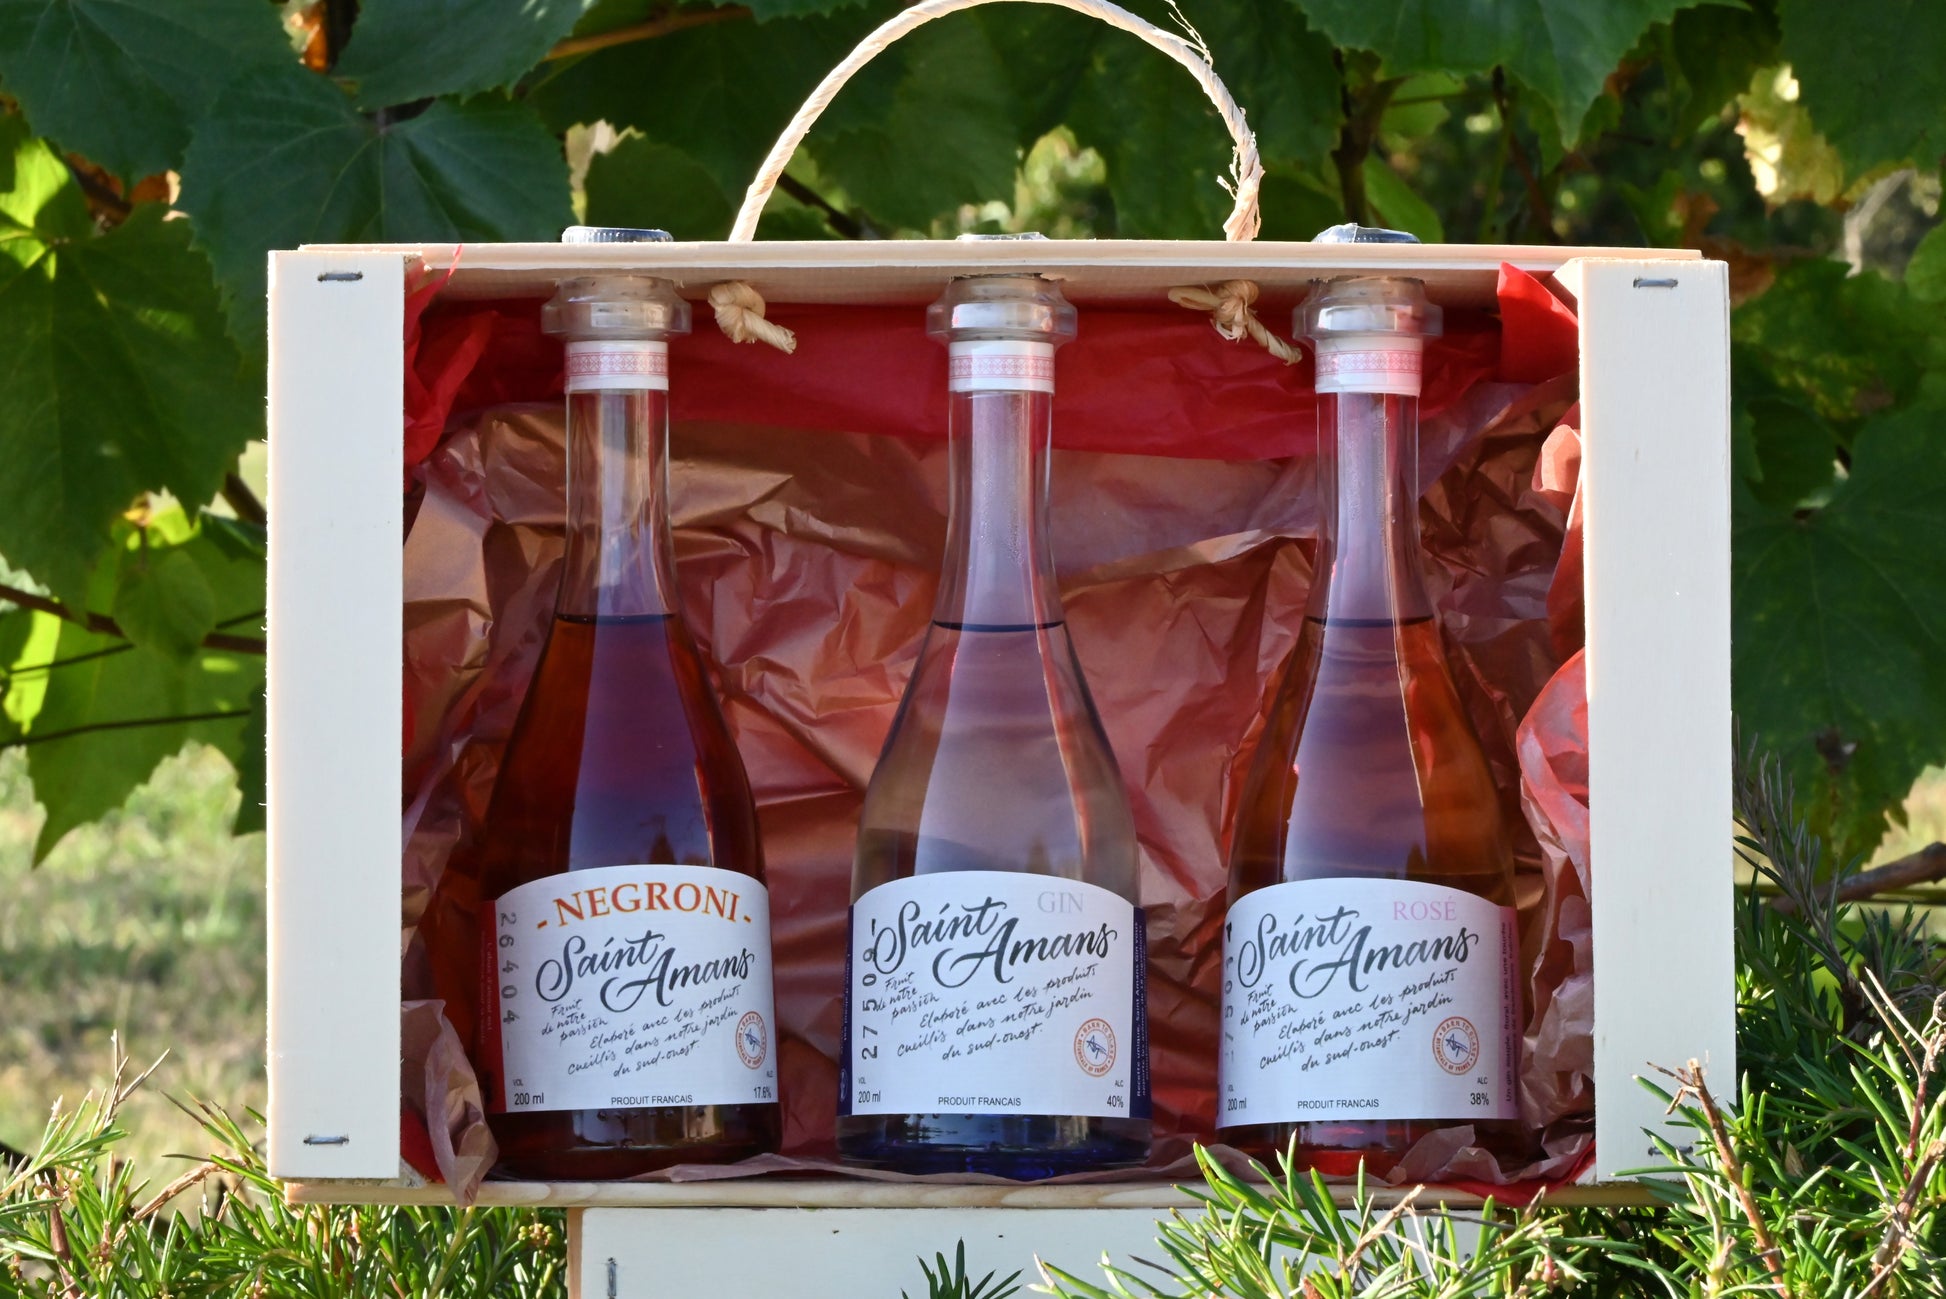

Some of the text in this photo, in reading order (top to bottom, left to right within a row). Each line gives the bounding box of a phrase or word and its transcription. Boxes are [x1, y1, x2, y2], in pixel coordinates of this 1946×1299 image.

[1037, 891, 1084, 914] GIN
[932, 917, 1118, 988] Amans
[1289, 925, 1479, 999] Amans
[599, 947, 755, 1013] Amans
[885, 971, 915, 992] Fruit
[874, 986, 918, 1012] de notre
[920, 963, 1099, 1028] Elaboré avec les produits
[1247, 983, 1274, 1006] Fruit
[1278, 968, 1458, 1040] Elaboré avec les produits
[551, 999, 582, 1018] Fruit
[589, 984, 741, 1049] Elaboré avec les produits
[891, 992, 940, 1025] passion
[956, 1017, 995, 1036] dans
[1001, 1002, 1045, 1023] notre
[1045, 986, 1093, 1019] jardin
[1240, 998, 1277, 1026] de notre
[1314, 1026, 1352, 1047] dans
[1356, 1010, 1401, 1029] notre
[1402, 992, 1453, 1026] jardin
[541, 1012, 585, 1036] de notre
[560, 1017, 608, 1047] passion
[625, 1037, 659, 1055] dans
[665, 1022, 700, 1042] notre
[701, 1006, 738, 1036] jardin
[1253, 1003, 1298, 1039] passion
[942, 1044, 961, 1061] du
[1301, 1055, 1320, 1072] du
[613, 1063, 630, 1077] du
[1477, 1076, 1488, 1085] ALC
[514, 1092, 545, 1106] 200 ml
[611, 1094, 693, 1106] PRODUIT FRANCAIS
[753, 1086, 772, 1099] 17.6%
[858, 1090, 881, 1104] 200 ml
[938, 1097, 1021, 1107] PRODUIT FRANCAIS
[1107, 1095, 1124, 1108] 40%
[1297, 1099, 1379, 1109] PRODUIT FRANCAIS
[1470, 1092, 1489, 1106] 38%
[1227, 1098, 1247, 1111] 200 ml
